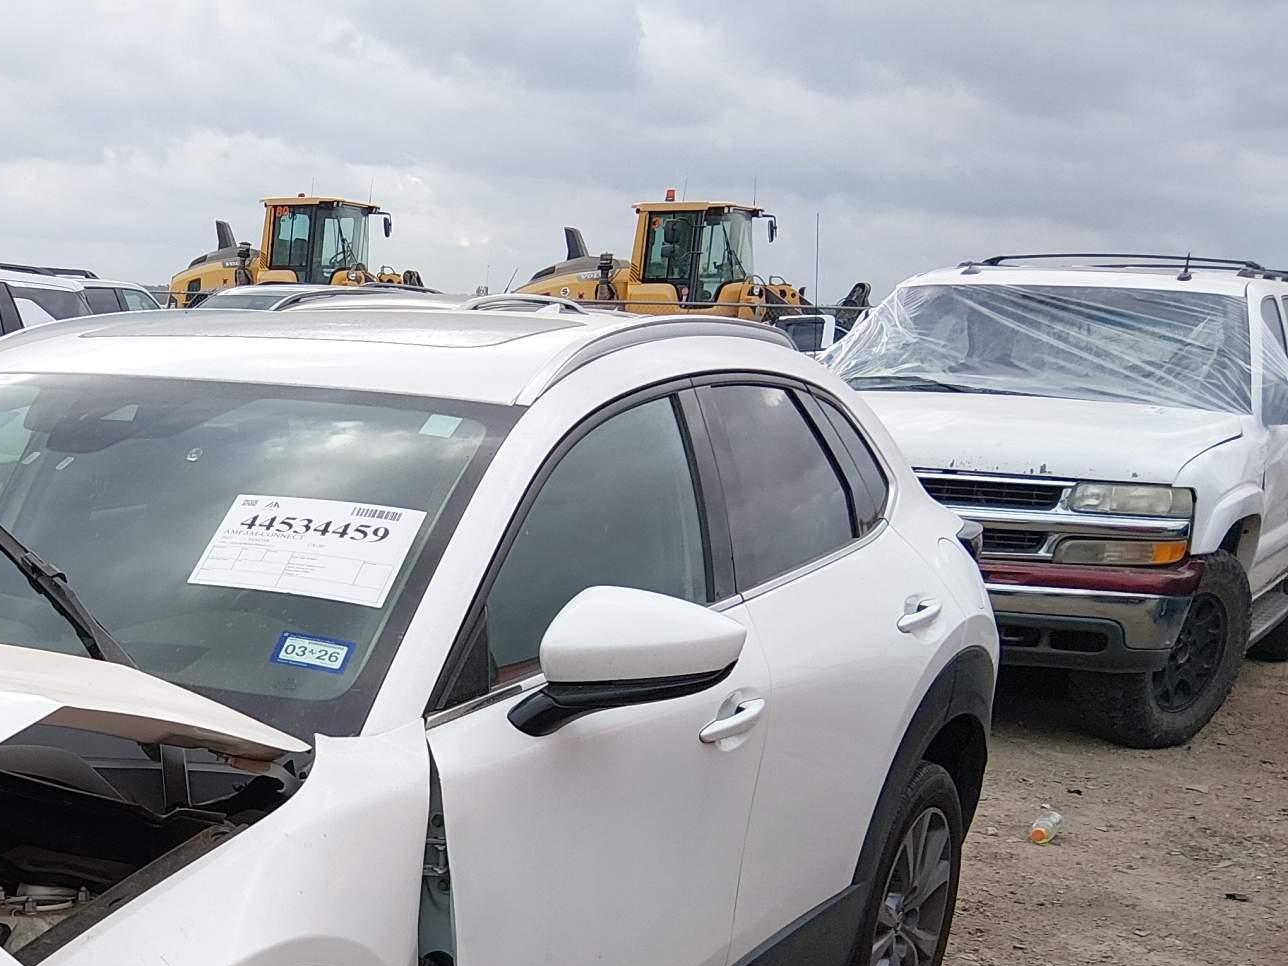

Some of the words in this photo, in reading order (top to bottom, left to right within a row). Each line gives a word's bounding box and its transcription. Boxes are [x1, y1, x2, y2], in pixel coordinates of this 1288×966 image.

[240, 514, 390, 543] 44534459
[284, 644, 308, 657] 03
[315, 649, 341, 663] 26
